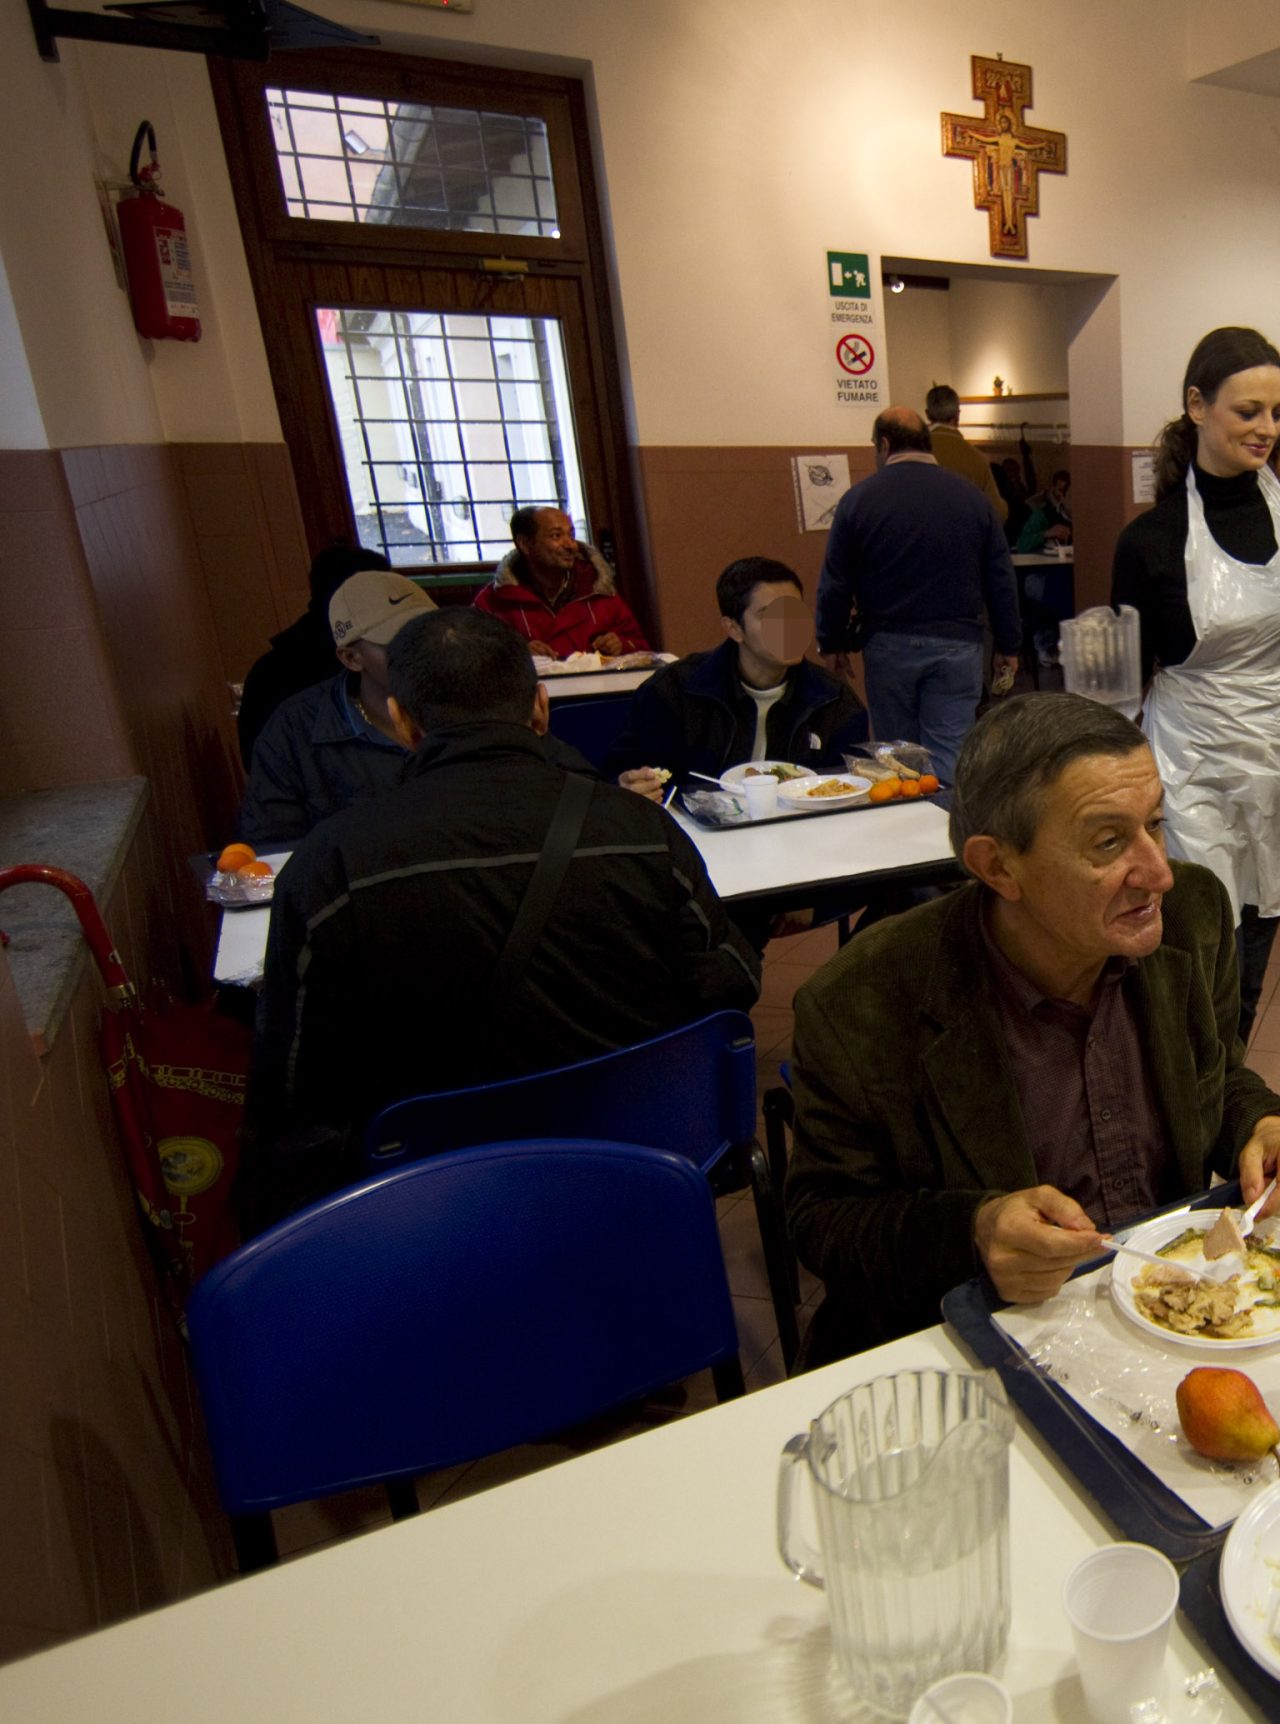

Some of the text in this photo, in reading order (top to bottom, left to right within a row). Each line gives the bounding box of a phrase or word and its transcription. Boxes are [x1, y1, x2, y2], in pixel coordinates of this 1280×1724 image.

[835, 301, 868, 312] USCITA DI
[832, 313, 873, 324] EMERGENZA
[837, 379, 878, 390] VIETATO
[837, 391, 879, 402] FUMARE
